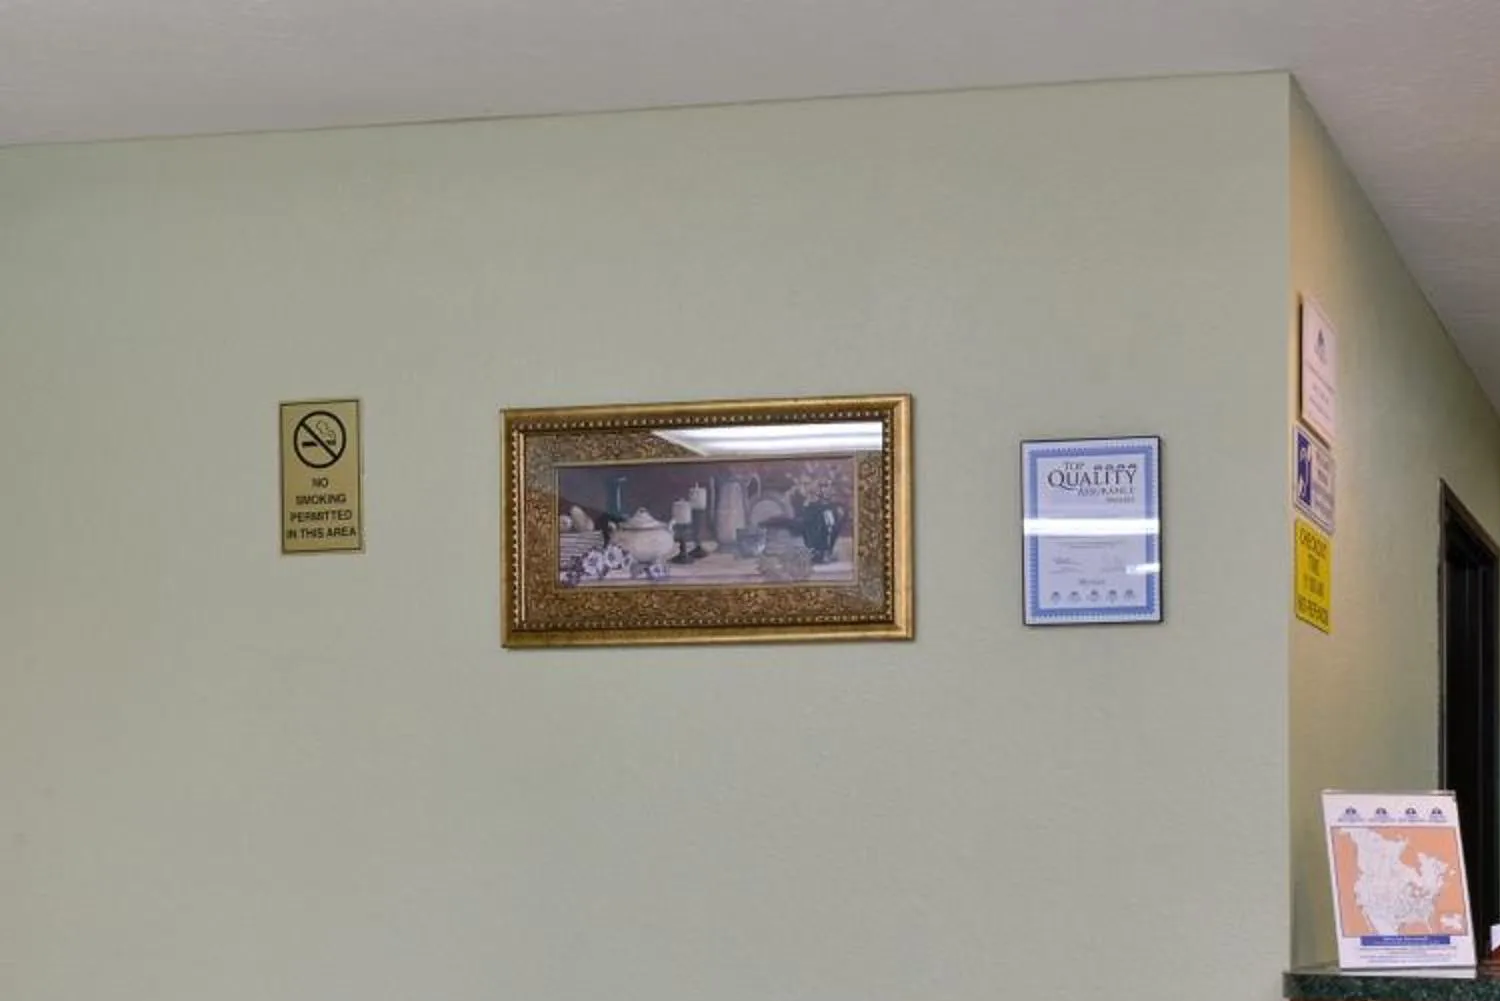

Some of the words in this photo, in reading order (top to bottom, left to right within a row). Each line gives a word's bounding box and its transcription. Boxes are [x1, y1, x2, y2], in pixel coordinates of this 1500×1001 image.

[312, 477, 329, 488] NO
[1047, 468, 1137, 491] QUALITY
[295, 493, 347, 505] SMOKING
[289, 509, 353, 523] PERMITTED
[300, 527, 325, 539] THIS
[326, 526, 357, 537] AREA
